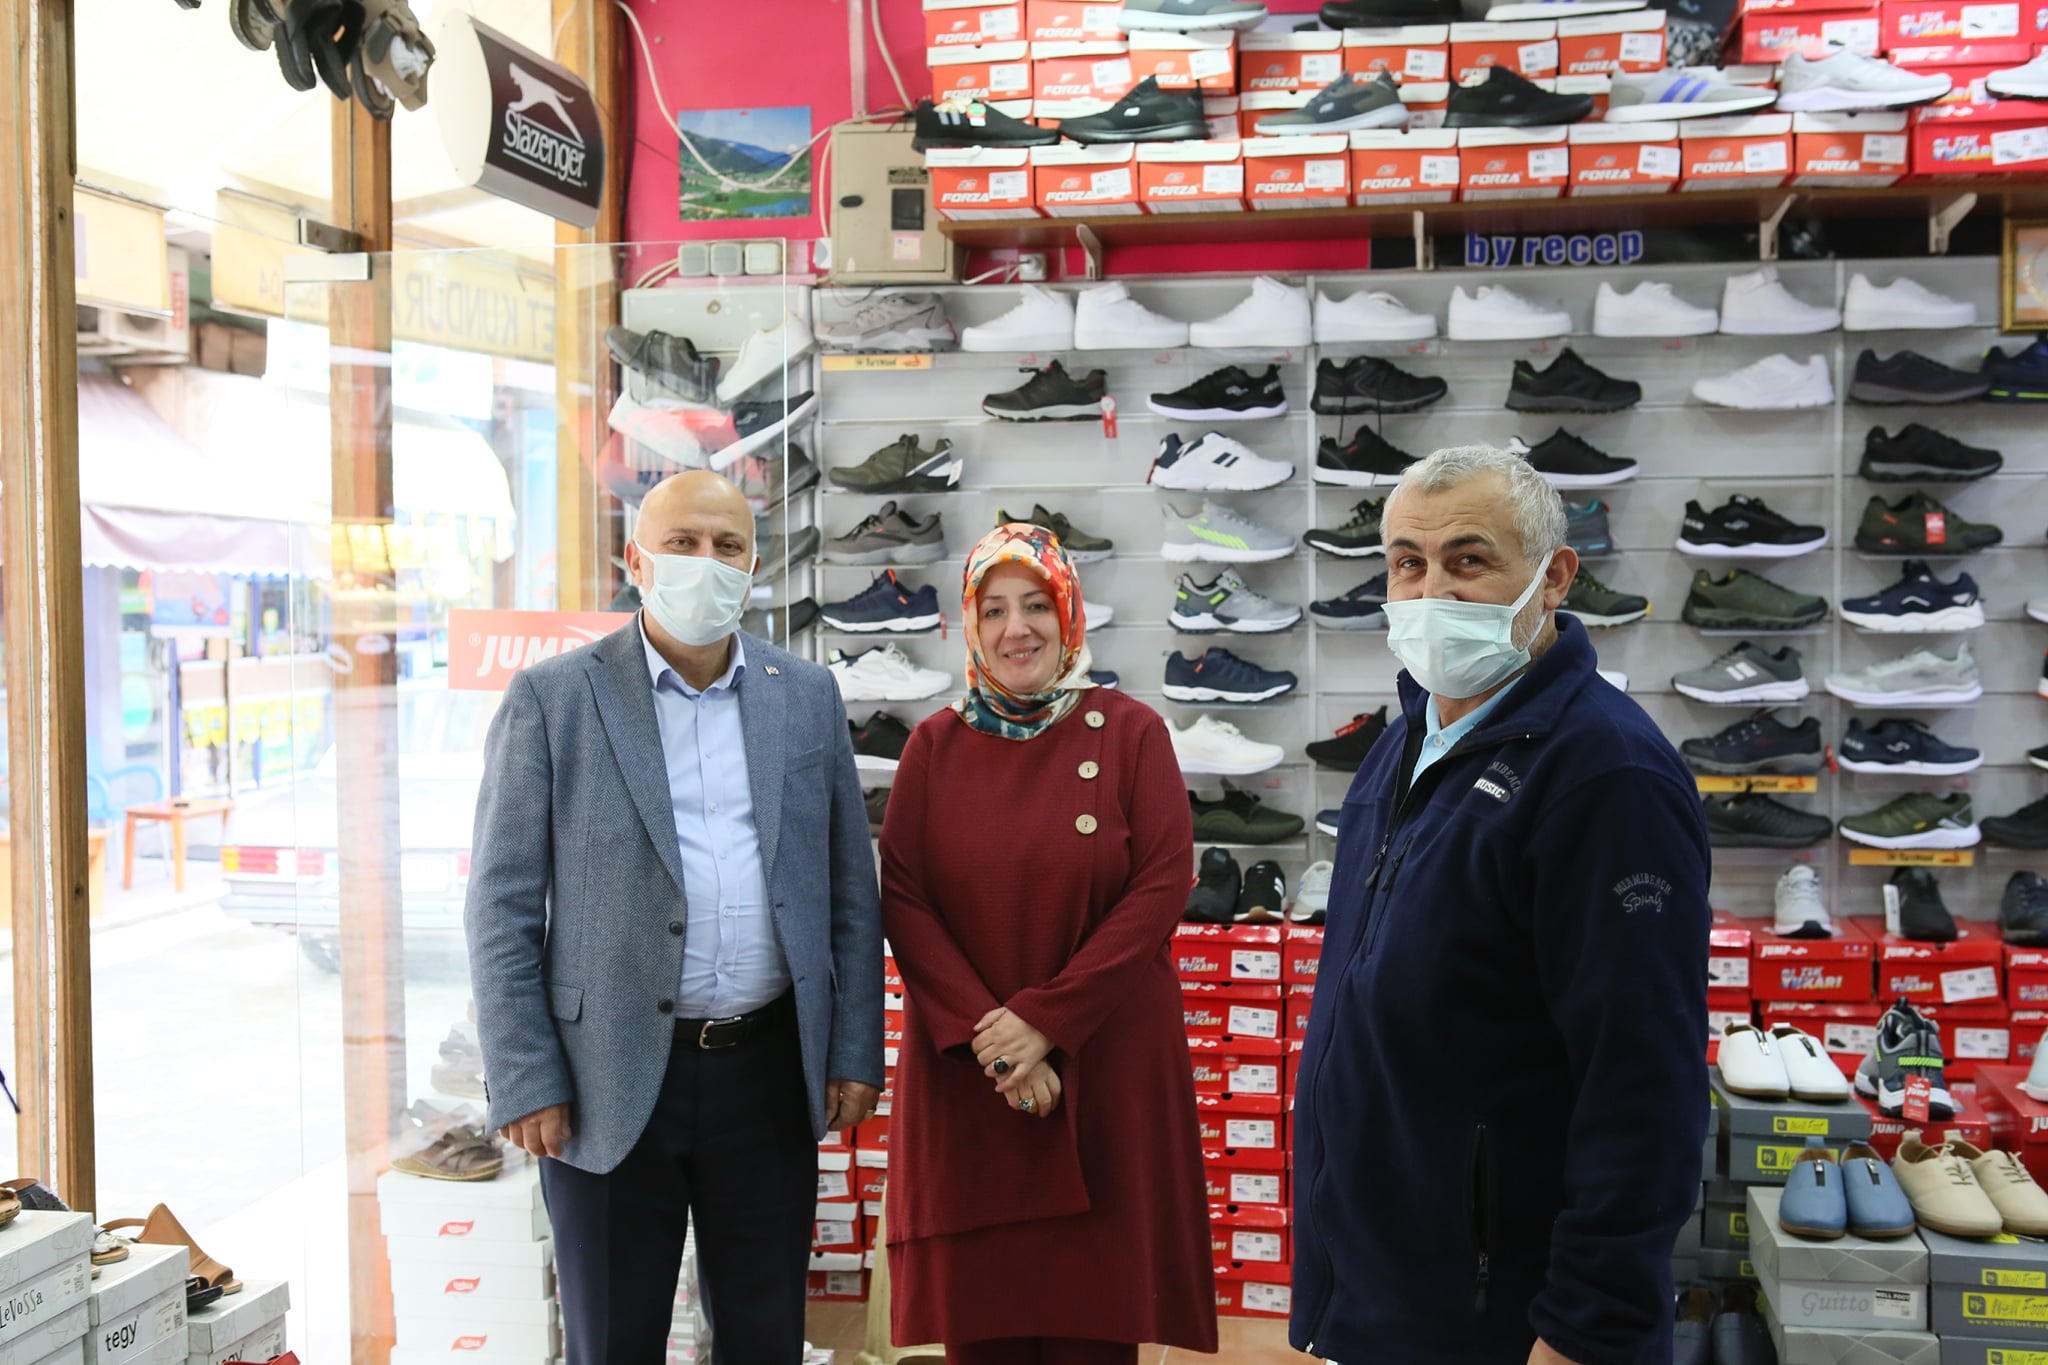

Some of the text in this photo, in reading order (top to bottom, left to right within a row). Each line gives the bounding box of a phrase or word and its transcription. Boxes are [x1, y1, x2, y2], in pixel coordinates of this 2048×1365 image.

[935, 32, 983, 45] FORZA
[1035, 28, 1083, 39] FORZA
[1568, 60, 1620, 73] FORZA
[1250, 77, 1300, 89] FORZA
[942, 88, 991, 100] FORZA
[1043, 84, 1091, 96] FORZA
[503, 108, 585, 181] Slazenger
[1692, 161, 1744, 174] FORZA
[1806, 160, 1861, 172] FORZA
[1469, 172, 1521, 185] FORZA
[1578, 168, 1632, 182] FORZA
[1254, 182, 1306, 194] FORZA
[1360, 177, 1412, 190] FORZA
[1045, 190, 1095, 202] FORZA
[1148, 185, 1198, 197] FORZA
[941, 192, 991, 203] FORZA
[1465, 230, 1645, 268] by recep
[1176, 926, 1204, 937] JUMP
[1287, 928, 1316, 940] JUMP
[1760, 945, 1793, 958] JUMP
[1884, 946, 1915, 959] JUMP
[2010, 953, 2043, 966] JUMP
[1181, 981, 1202, 990] UMP
[2012, 1010, 2043, 1022] JUMP
[1871, 1123, 1904, 1135] JUMP
[1801, 1291, 1870, 1317] Guitto
[105, 1320, 139, 1352] tegy
